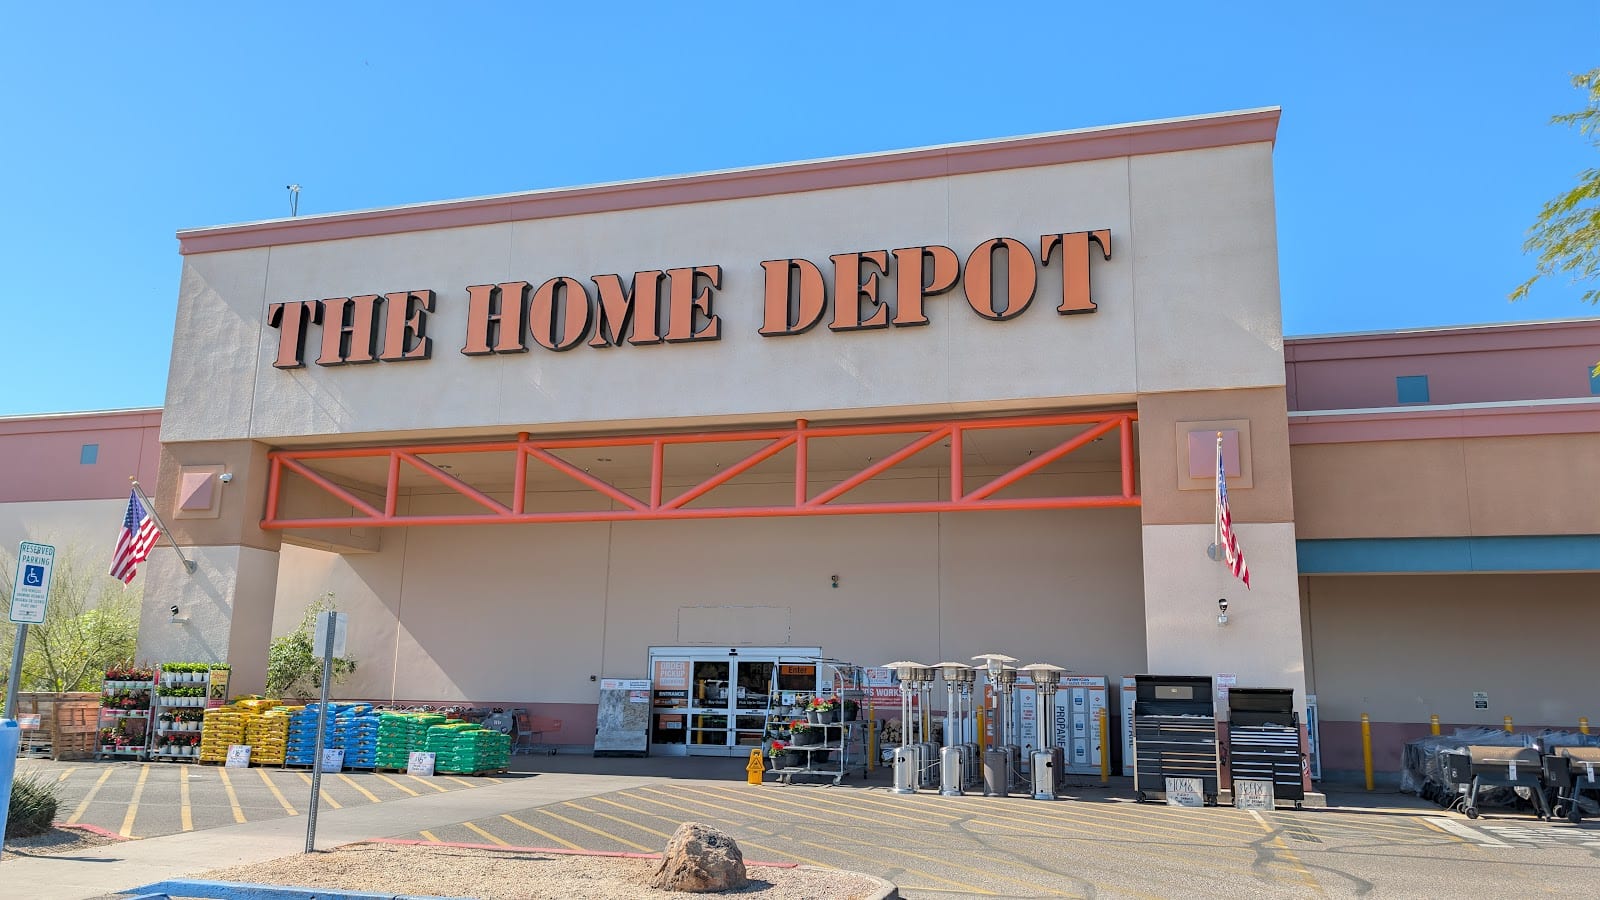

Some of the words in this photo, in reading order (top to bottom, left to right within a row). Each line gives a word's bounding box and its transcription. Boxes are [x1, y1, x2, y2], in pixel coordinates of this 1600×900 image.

[267, 289, 437, 370] THE
[461, 265, 722, 357] HOME
[758, 228, 1112, 337] DEPOT
[22, 544, 53, 556] RESERVED
[22, 554, 50, 566] PARKING
[788, 666, 807, 674] Enter
[1056, 705, 1066, 748] PROPANE
